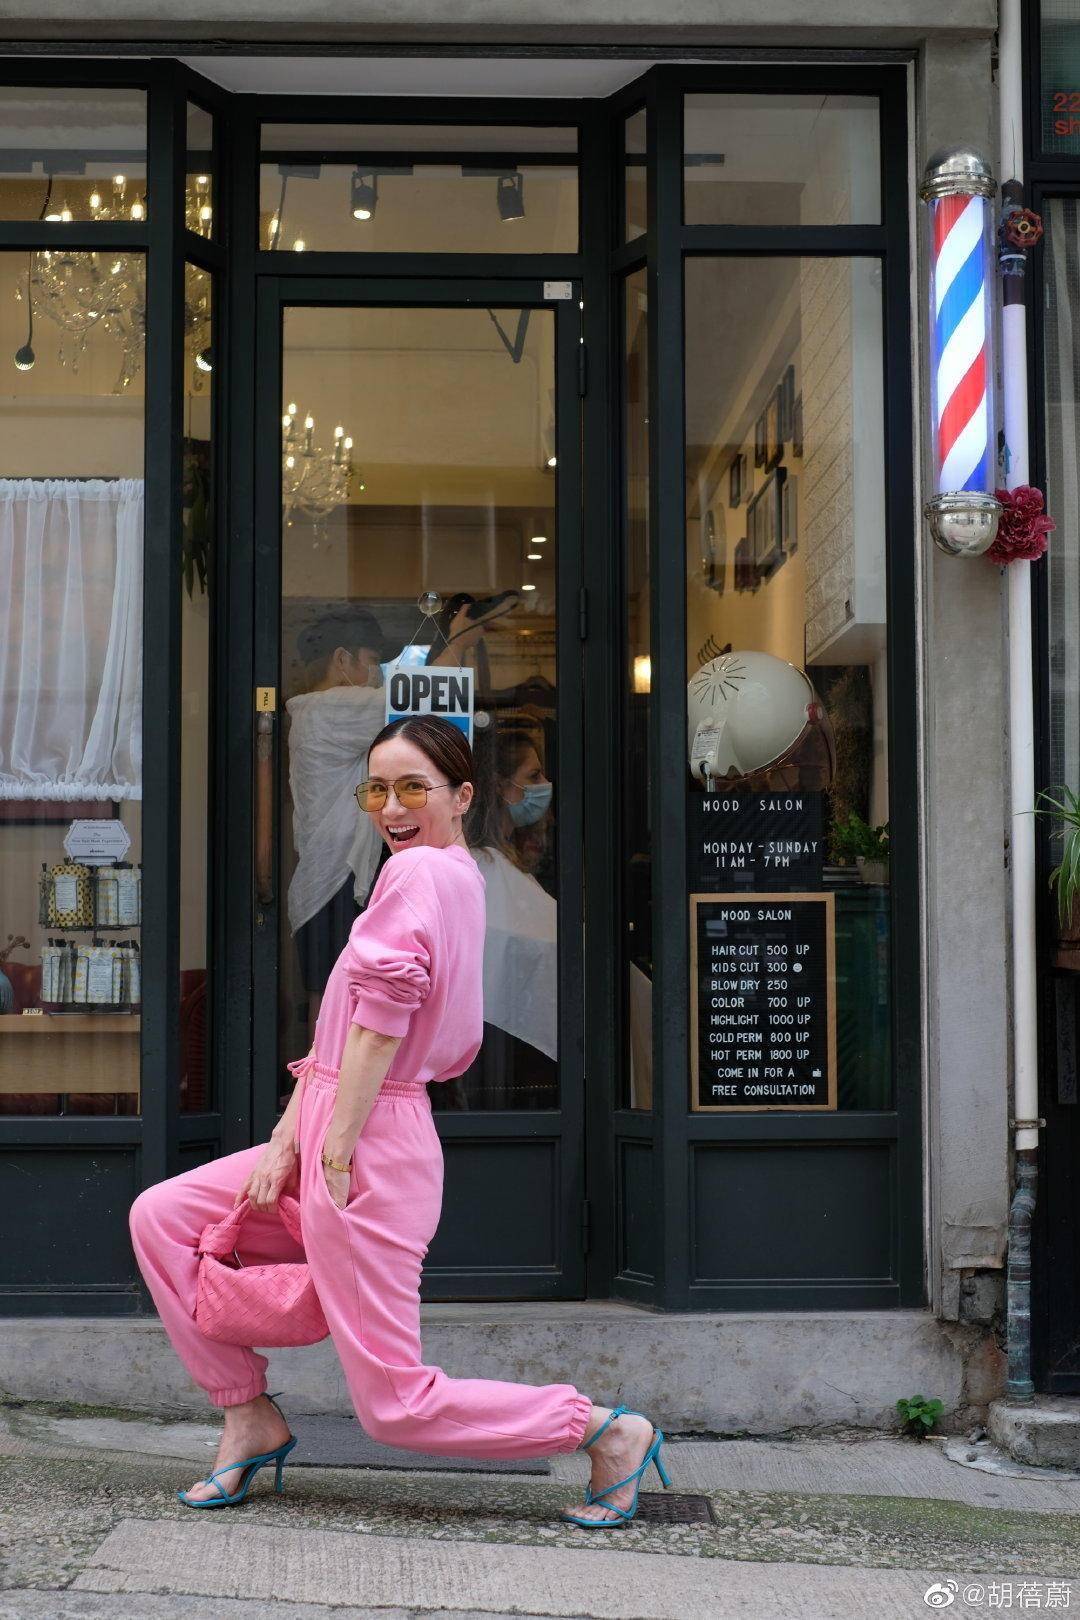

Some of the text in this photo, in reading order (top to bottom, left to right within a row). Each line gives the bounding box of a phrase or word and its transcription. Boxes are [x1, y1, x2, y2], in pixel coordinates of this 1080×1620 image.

[1052, 92, 1080, 112] 22
[390, 673, 469, 713] OPEN
[702, 799, 803, 812] MOOD SALON
[721, 910, 792, 920] MOOD SALON
[711, 944, 810, 955] HAIR CUT 500 UP
[711, 962, 788, 973] KIDS CUT 300
[711, 980, 788, 990] BLOW DRY 250
[711, 997, 811, 1008] COLOR 700 UP
[710, 1014, 811, 1025] HIGHLIGHT 1000 UP
[709, 1032, 810, 1043] COLD PERM 800 UP
[711, 1050, 810, 1060] HOT PERM 1800 UP
[717, 1068, 795, 1078] COME IN FOR A
[712, 1084, 815, 1096] FREE CONSULTATION
